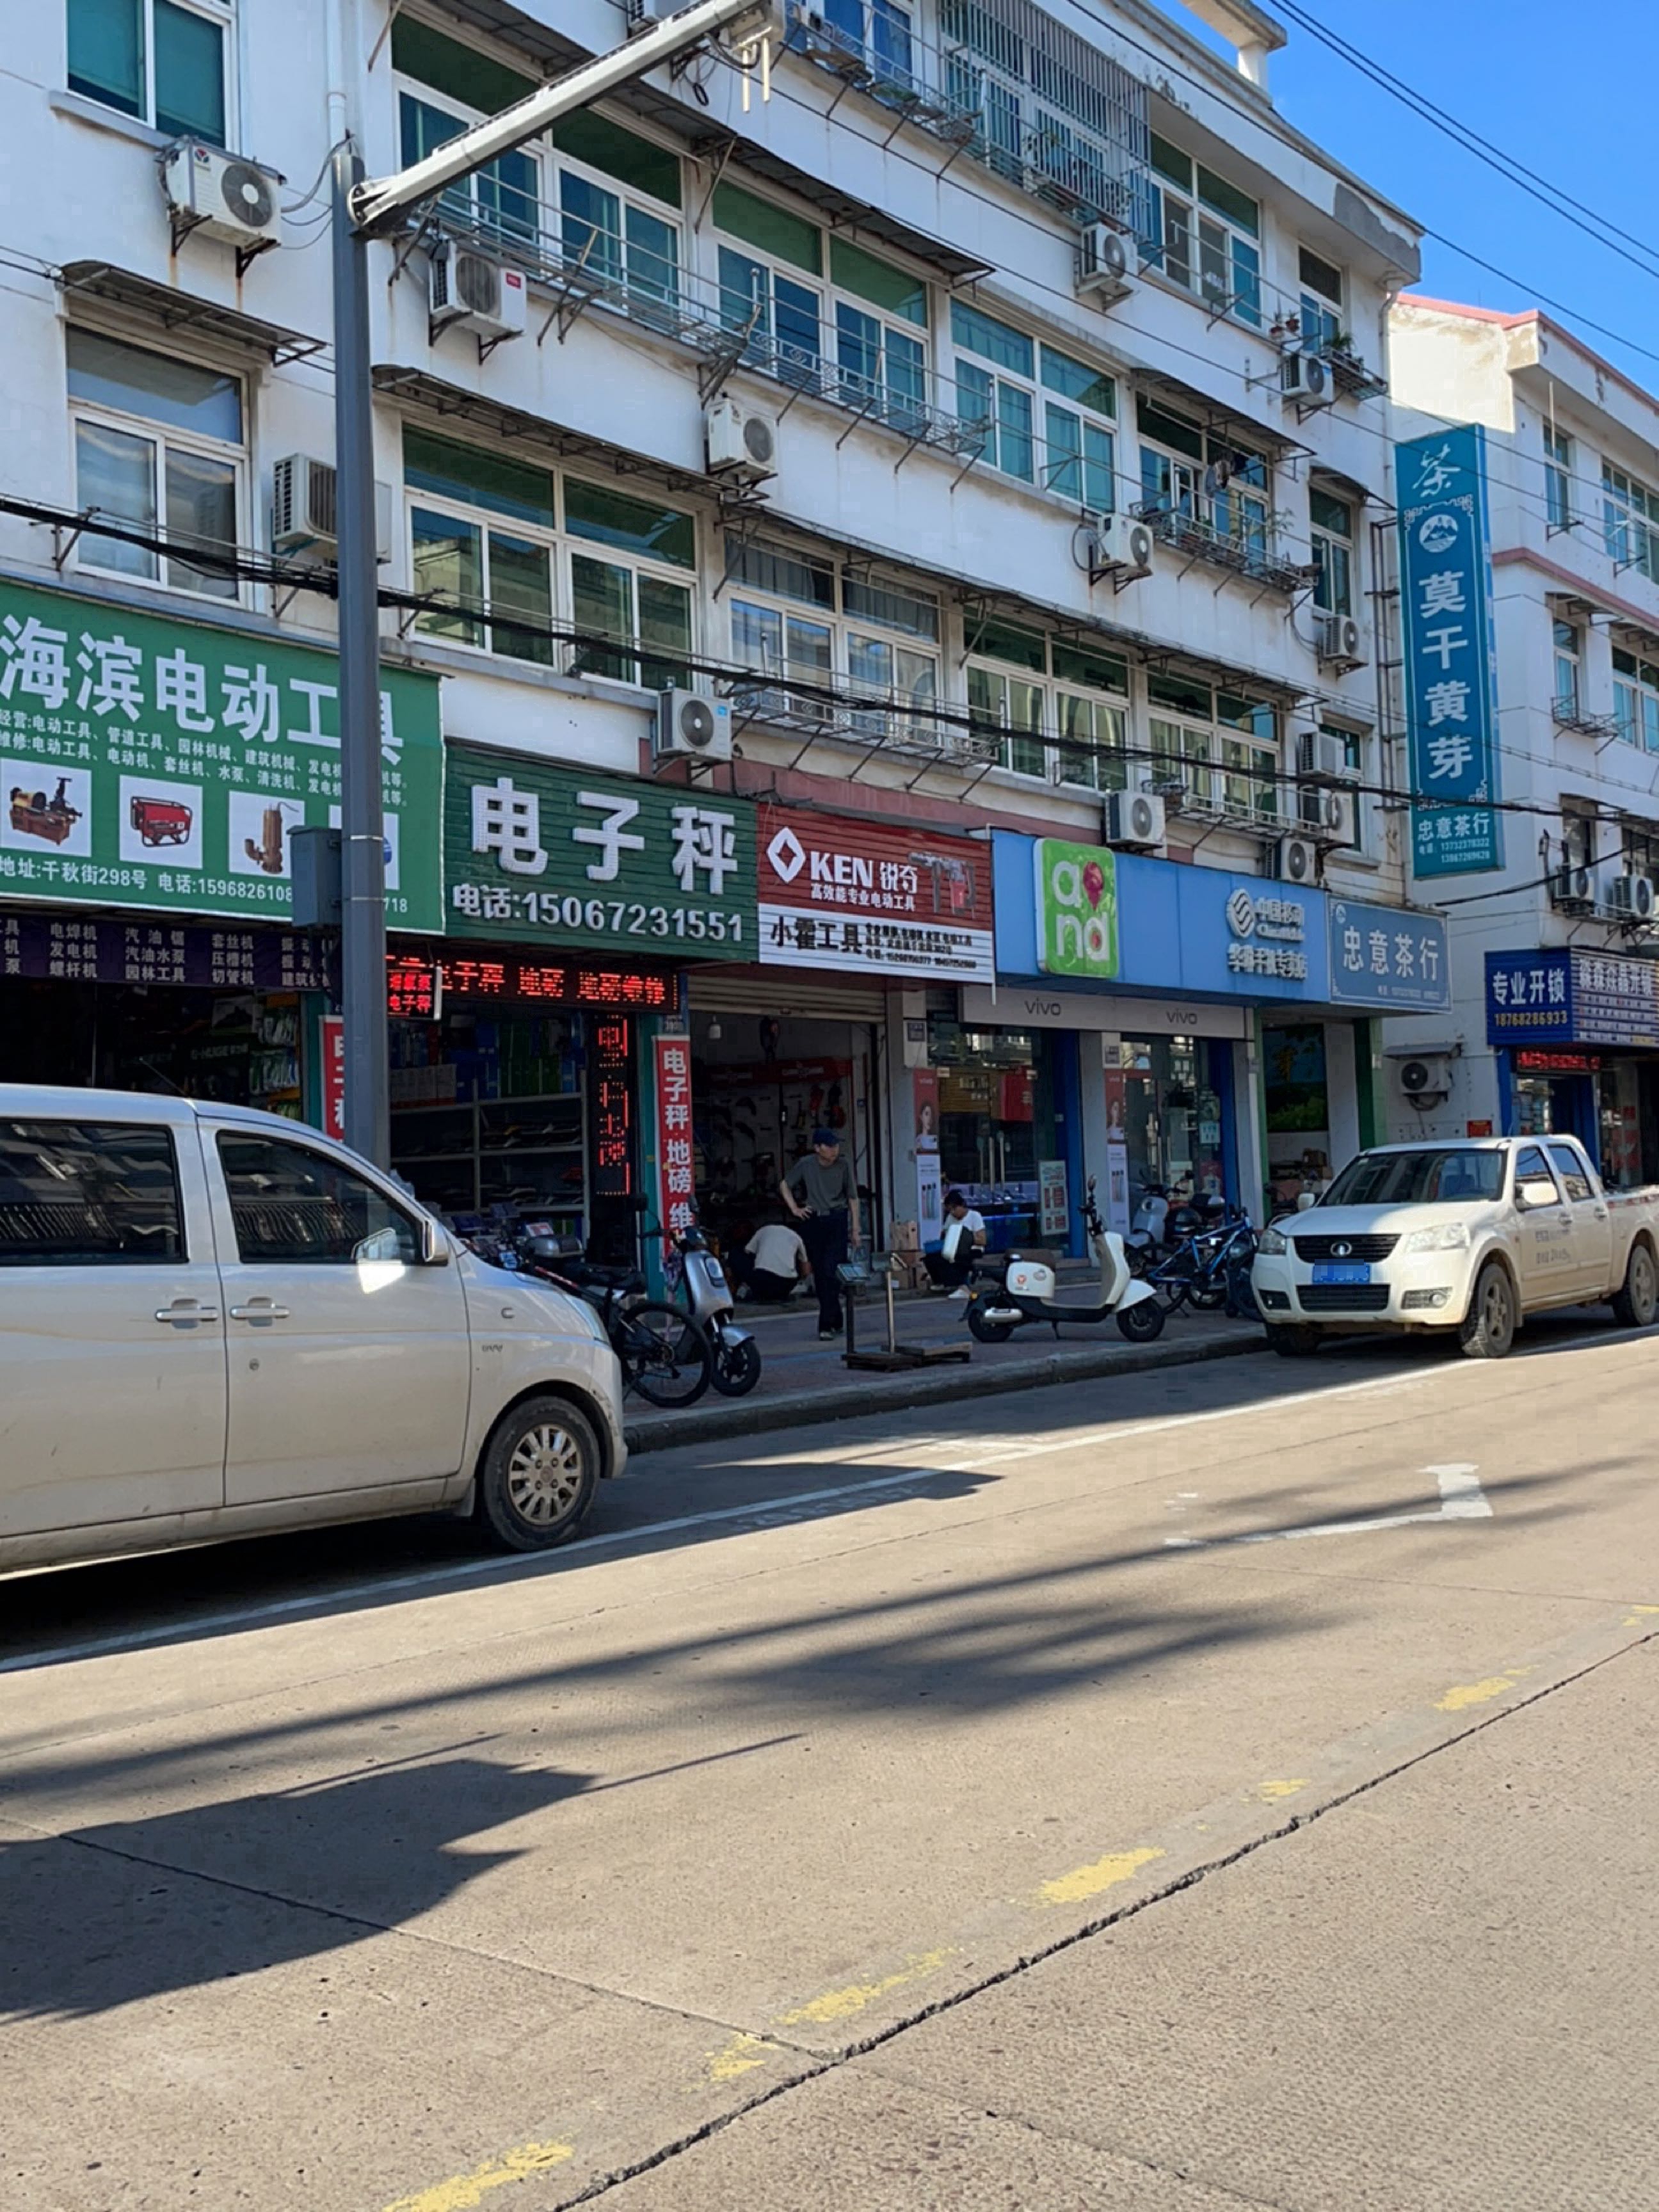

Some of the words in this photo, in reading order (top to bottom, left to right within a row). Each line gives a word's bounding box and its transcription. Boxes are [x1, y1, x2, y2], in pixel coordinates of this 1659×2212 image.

[1417, 570, 1473, 780] 莫干黄芽
[471, 776, 738, 895] 电子秤
[1418, 812, 1489, 842] 忠意茶行
[810, 851, 874, 888] KEN
[879, 862, 918, 894] 锐奇
[453, 883, 742, 943] 电话:15067231551
[50, 941, 97, 959] 发电机
[1343, 925, 1439, 981] 忠意茶行
[1025, 997, 1062, 1016] vivo
[1493, 967, 1566, 1006] 专业开锁
[1166, 1008, 1198, 1025] vivo
[662, 1047, 689, 1131] 电子秤
[667, 1138, 692, 1194] 地磅
